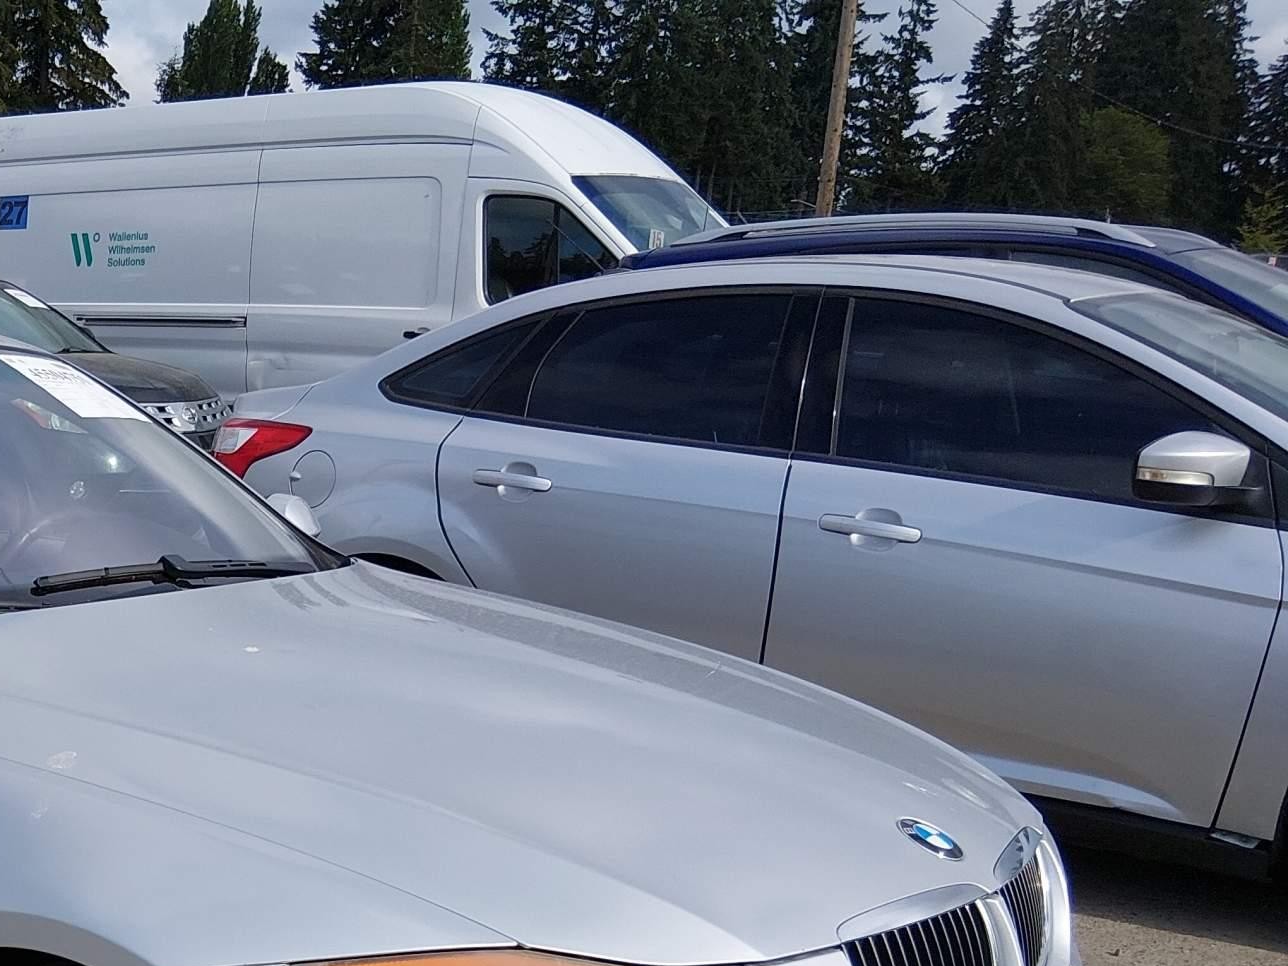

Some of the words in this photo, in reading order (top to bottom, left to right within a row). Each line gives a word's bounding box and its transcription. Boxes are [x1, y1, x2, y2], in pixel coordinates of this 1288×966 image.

[0, 200, 28, 225] 27
[108, 232, 148, 242] Wallenius
[108, 244, 155, 255] Wilhelmsen
[107, 257, 146, 267] Solutions
